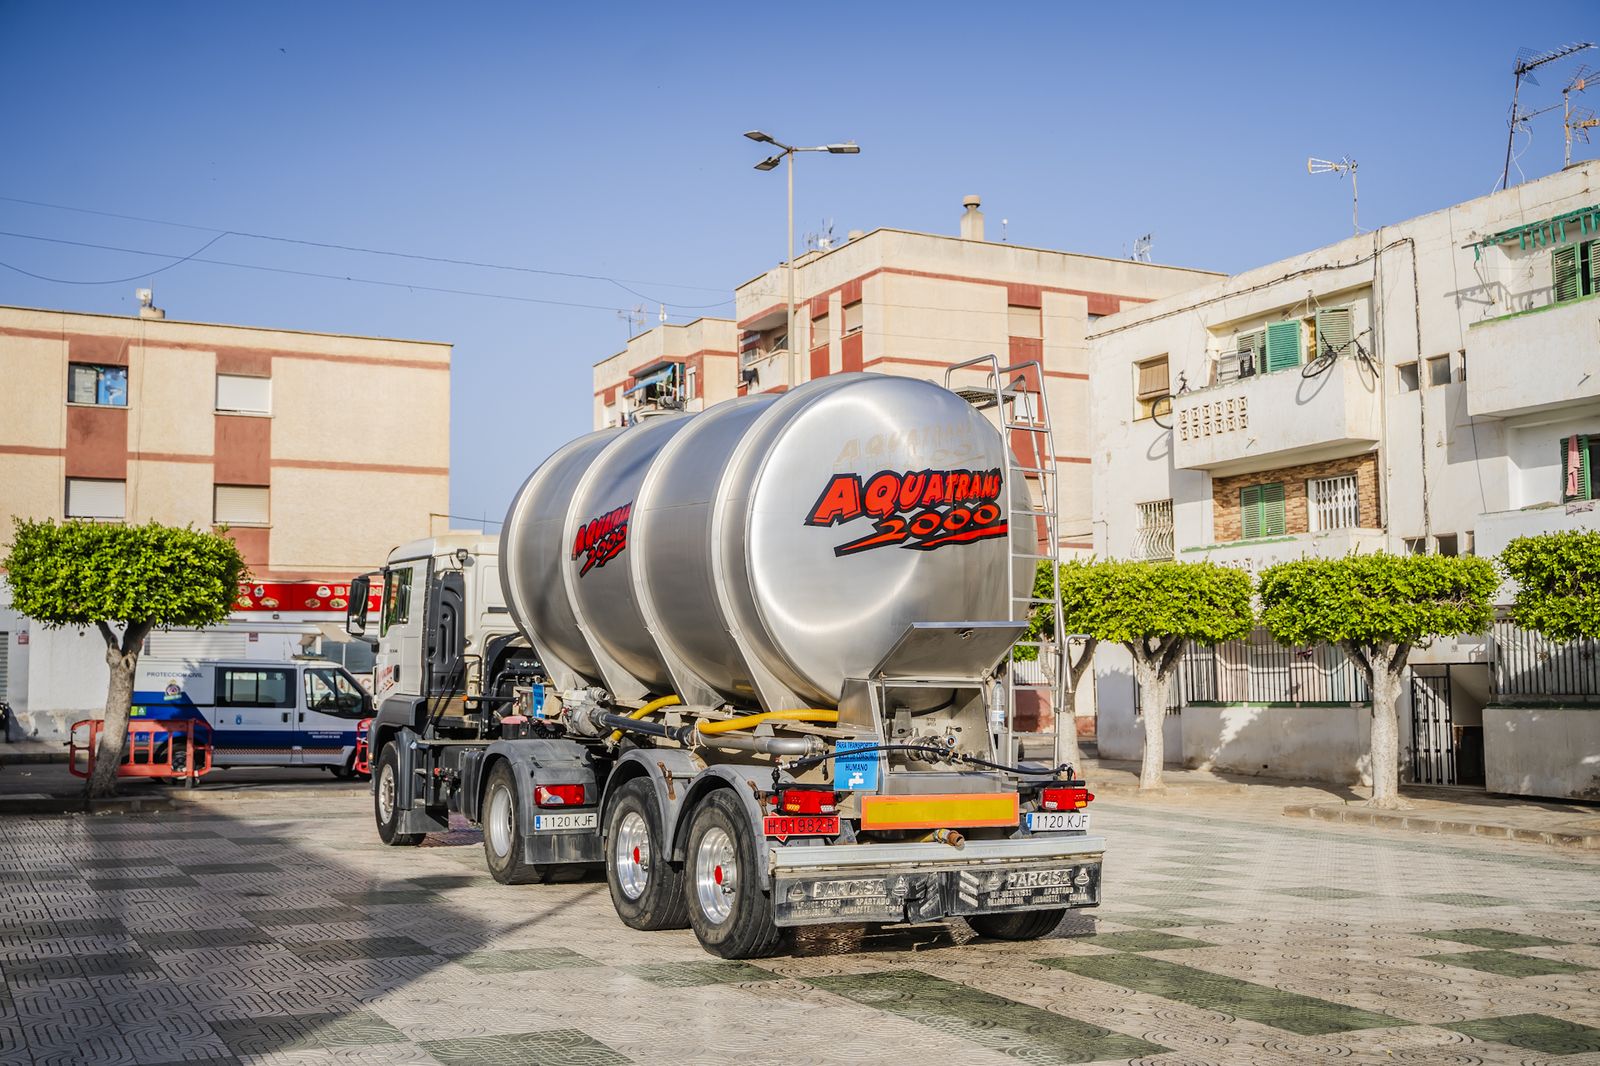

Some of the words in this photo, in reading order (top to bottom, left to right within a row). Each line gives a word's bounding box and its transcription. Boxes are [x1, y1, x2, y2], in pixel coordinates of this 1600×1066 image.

[804, 468, 1002, 527] AQUATRANS
[834, 503, 1001, 557] 2000
[845, 763, 869, 772] HUMANO
[544, 816, 571, 828] 1120
[574, 815, 594, 827] KJF
[1037, 815, 1064, 829] 1120
[1067, 814, 1088, 828] KJF
[1008, 869, 1072, 888] PARCISA
